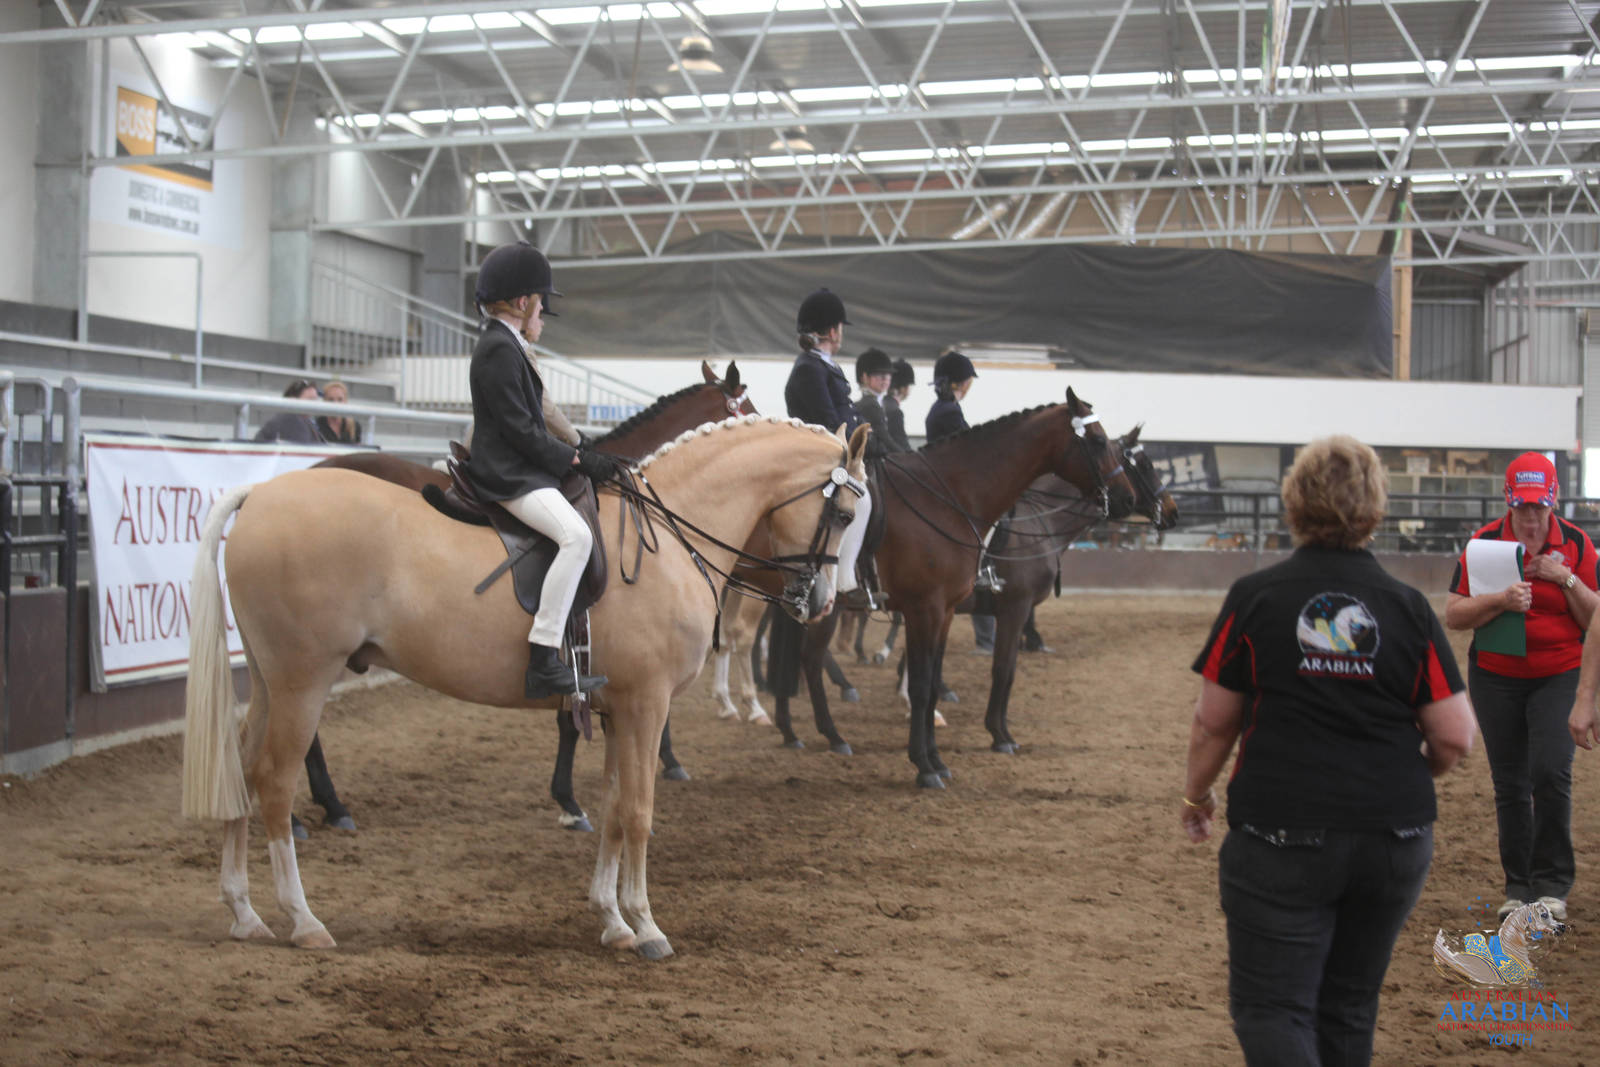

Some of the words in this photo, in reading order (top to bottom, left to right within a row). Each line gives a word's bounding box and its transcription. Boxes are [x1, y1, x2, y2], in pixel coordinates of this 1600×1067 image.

[118, 101, 155, 143] BOSS
[113, 475, 227, 545] AUSTR
[104, 580, 192, 646] NATION
[1299, 658, 1374, 675] ARABIAN
